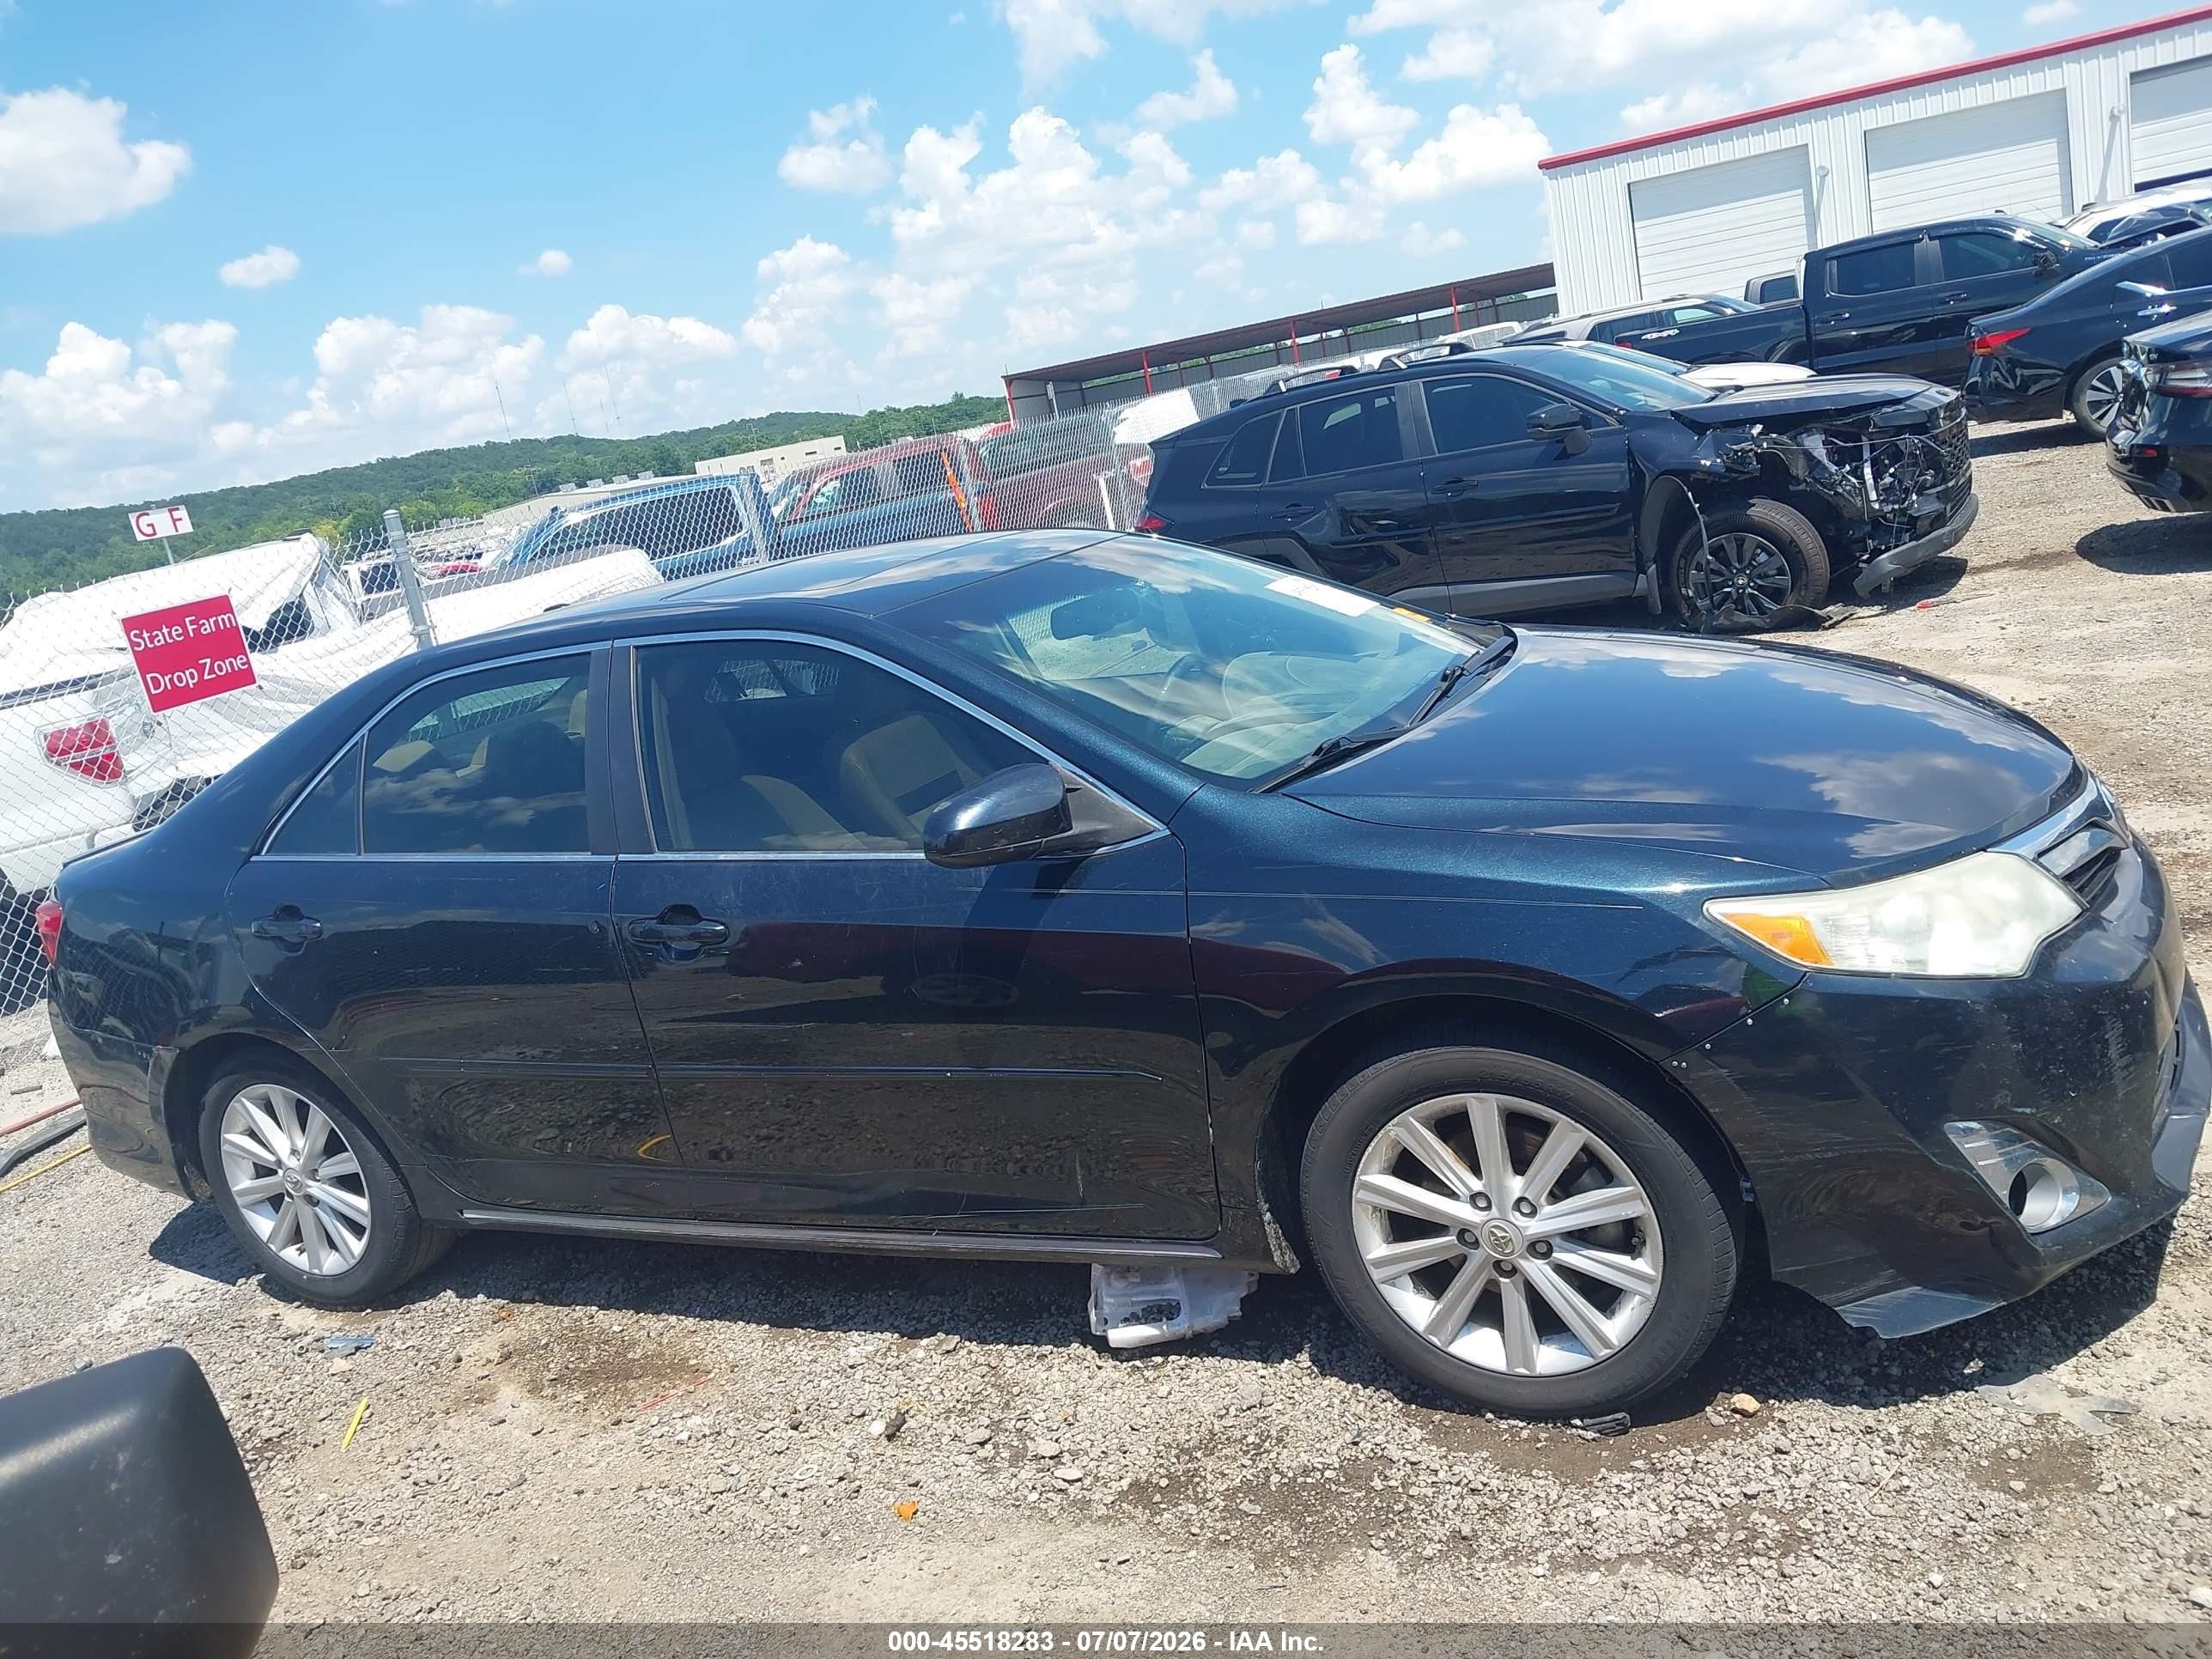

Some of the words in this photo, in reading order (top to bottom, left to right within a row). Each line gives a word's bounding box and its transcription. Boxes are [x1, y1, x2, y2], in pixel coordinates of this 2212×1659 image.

[136, 512, 157, 538] G
[167, 507, 183, 532] F
[130, 625, 185, 651] State
[184, 612, 237, 638] Farm
[145, 666, 198, 695] Drop
[198, 654, 249, 681] Zone
